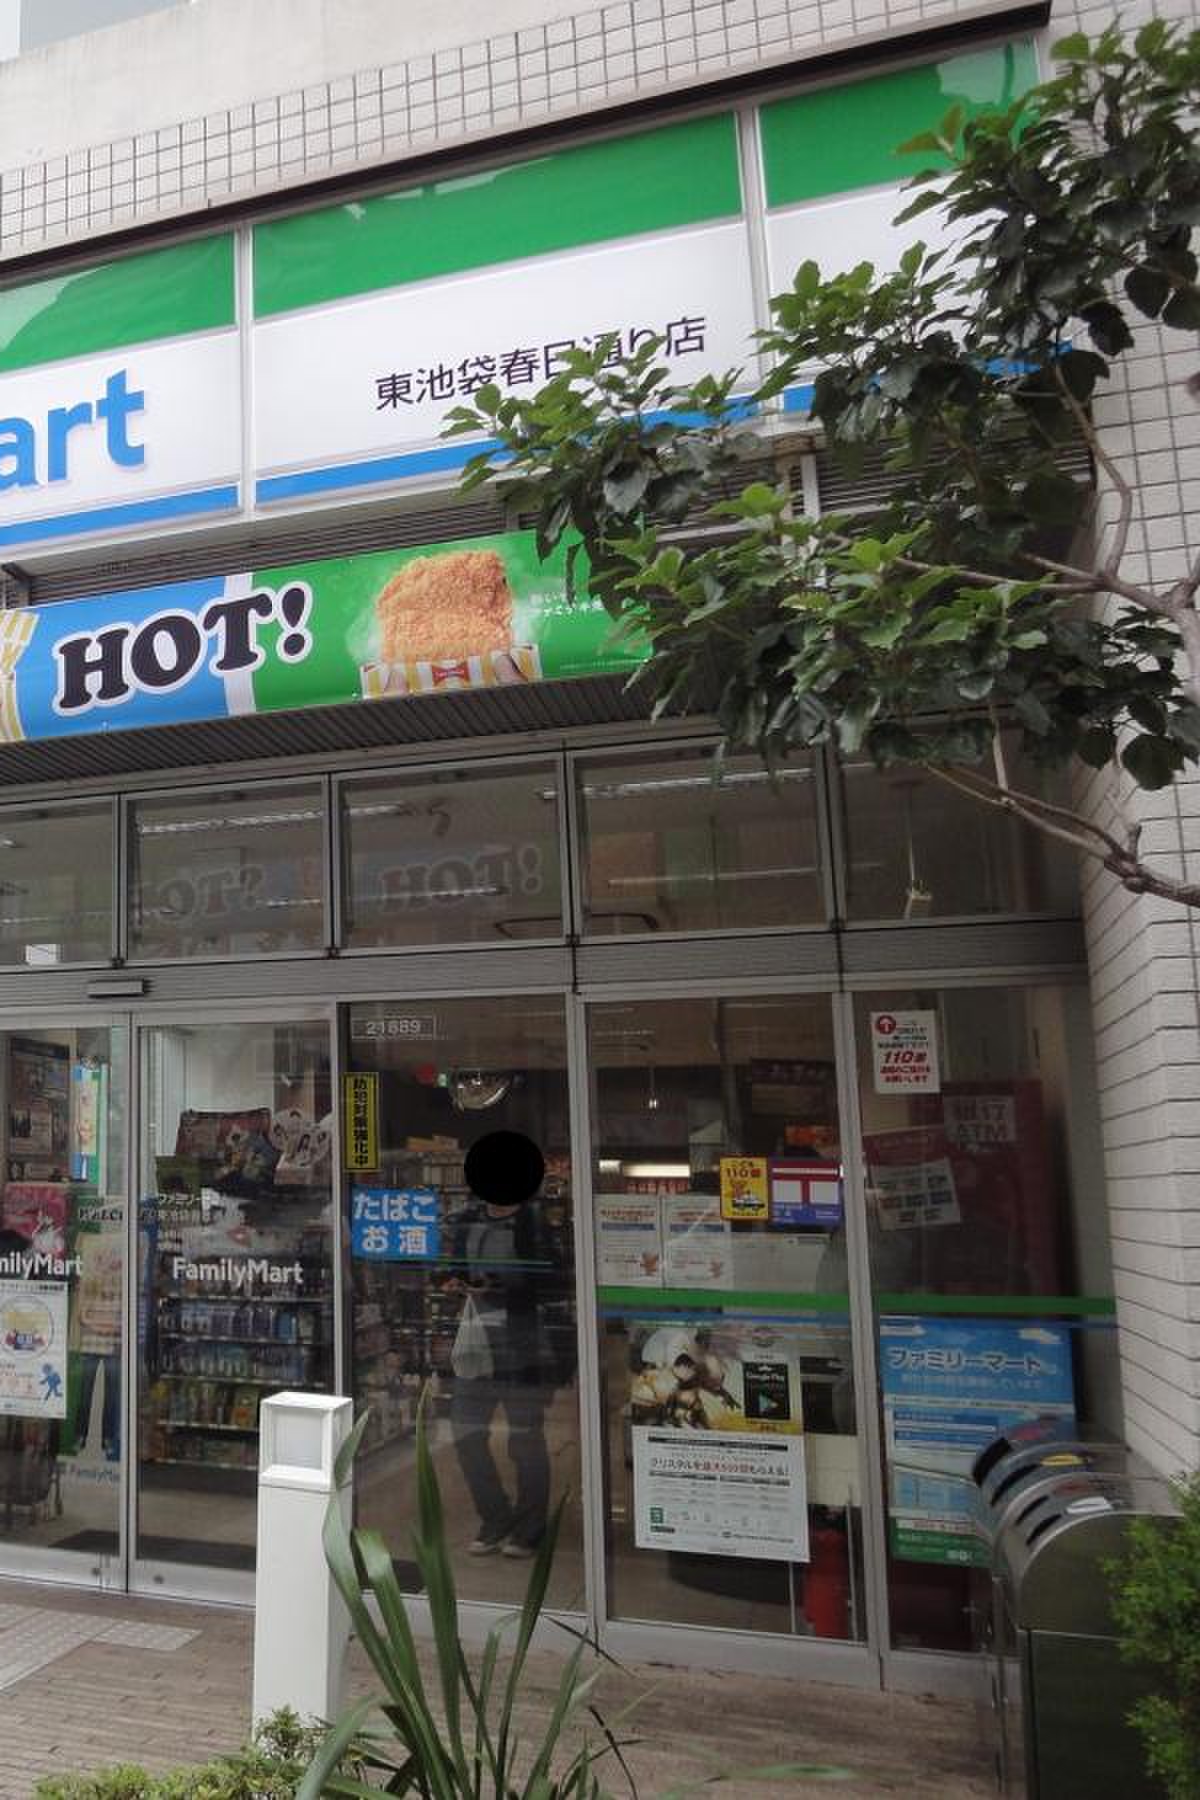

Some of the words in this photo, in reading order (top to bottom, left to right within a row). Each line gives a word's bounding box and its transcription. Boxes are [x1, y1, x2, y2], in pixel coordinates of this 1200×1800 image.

[55, 584, 309, 712] HOT!
[353, 1193, 436, 1221] たばこ
[362, 1225, 428, 1254] お酒
[173, 1257, 303, 1287] FamilyMart
[889, 1348, 1042, 1375] ファミリーマート
